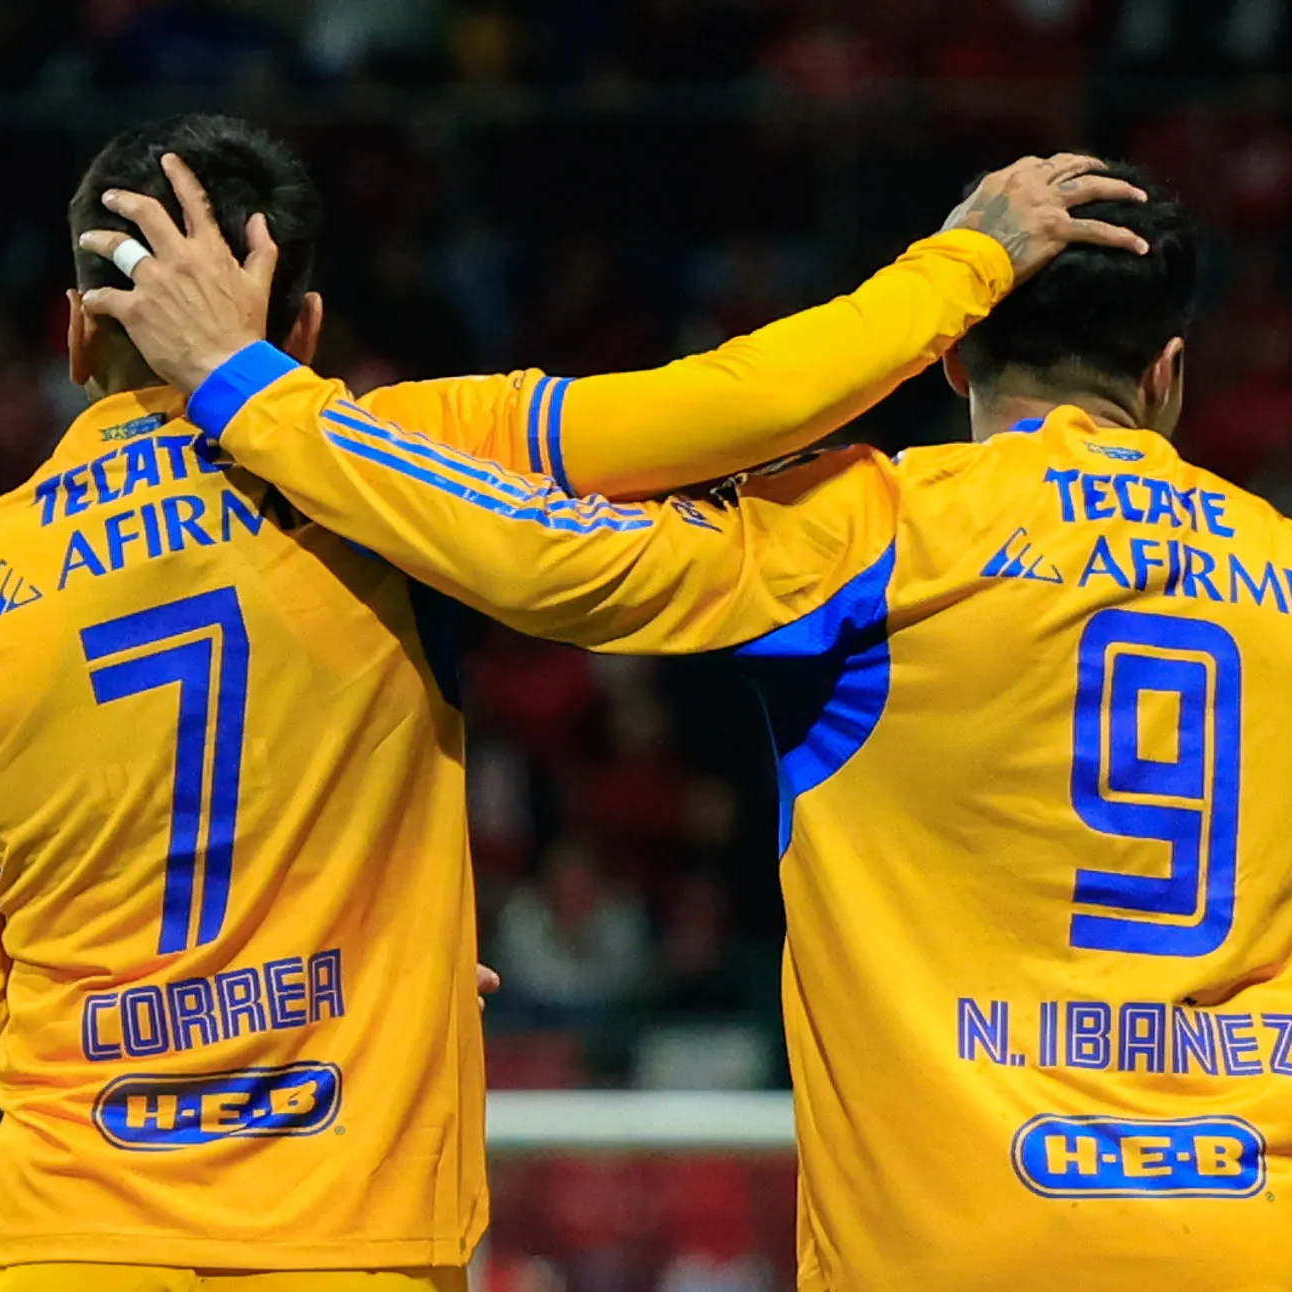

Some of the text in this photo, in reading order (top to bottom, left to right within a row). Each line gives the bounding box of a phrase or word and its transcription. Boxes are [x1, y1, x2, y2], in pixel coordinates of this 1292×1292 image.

[57, 489, 299, 592] AFIRM
[1043, 466, 1237, 539] TECATE
[79, 585, 250, 955] 7
[1068, 607, 1242, 958] 9
[82, 948, 345, 1062] CORREA
[1042, 1133, 1246, 1179] H-E-B
